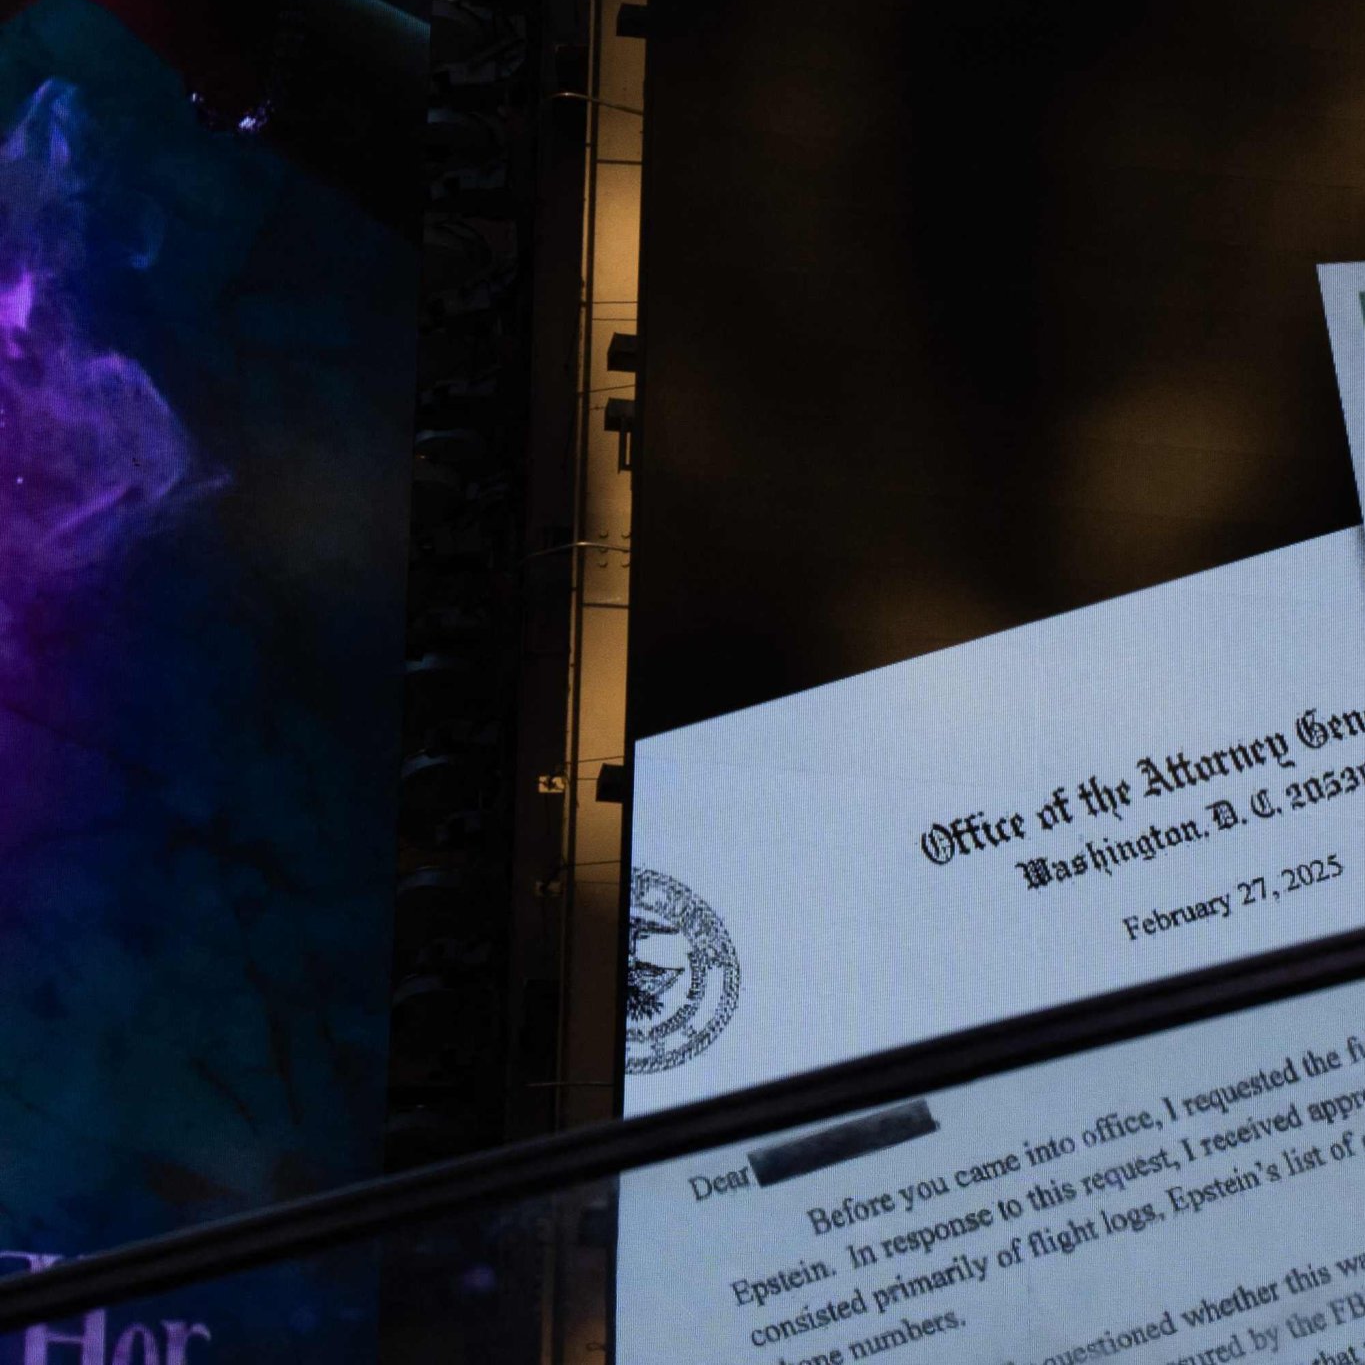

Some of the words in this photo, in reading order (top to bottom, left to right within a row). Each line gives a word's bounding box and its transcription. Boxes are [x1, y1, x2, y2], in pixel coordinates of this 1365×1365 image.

[921, 811, 1025, 865] Office
[1037, 786, 1070, 831] of
[1079, 775, 1132, 820] the
[1137, 731, 1296, 797] Attorney
[1123, 892, 1232, 940] February
[1238, 877, 1281, 906] 27,
[1281, 854, 1344, 892] 2025
[689, 1164, 750, 1202] Dear
[807, 1190, 896, 1236] Before
[899, 1172, 950, 1212] you
[955, 1152, 1021, 1188] came
[1024, 1134, 1076, 1167] into
[1082, 1106, 1164, 1148] office,
[1164, 1096, 1179, 1121] I
[1185, 1059, 1299, 1119] requested
[1303, 1044, 1342, 1076] the
[731, 1259, 838, 1308] Epstein.
[848, 1242, 878, 1271] In
[883, 1206, 995, 1255] response
[998, 1194, 1023, 1222] to
[1027, 1175, 1077, 1212] this
[1080, 1146, 1181, 1198] request,
[1181, 1137, 1197, 1163] I
[1200, 1105, 1303, 1158] received
[751, 1288, 869, 1348] consisted
[872, 1254, 989, 1315] primarily
[997, 1237, 1022, 1269] of
[1028, 1218, 1100, 1255] flight
[1100, 1201, 1167, 1235] logs,
[1166, 1161, 1283, 1215] Epstein's
[1284, 1140, 1326, 1176] list
[1330, 1130, 1355, 1162] of
[848, 1310, 967, 1361] numbers.
[1180, 1282, 1280, 1328] whether
[1284, 1262, 1332, 1295] this
[1247, 1326, 1280, 1354] by
[1285, 1308, 1328, 1339] the
